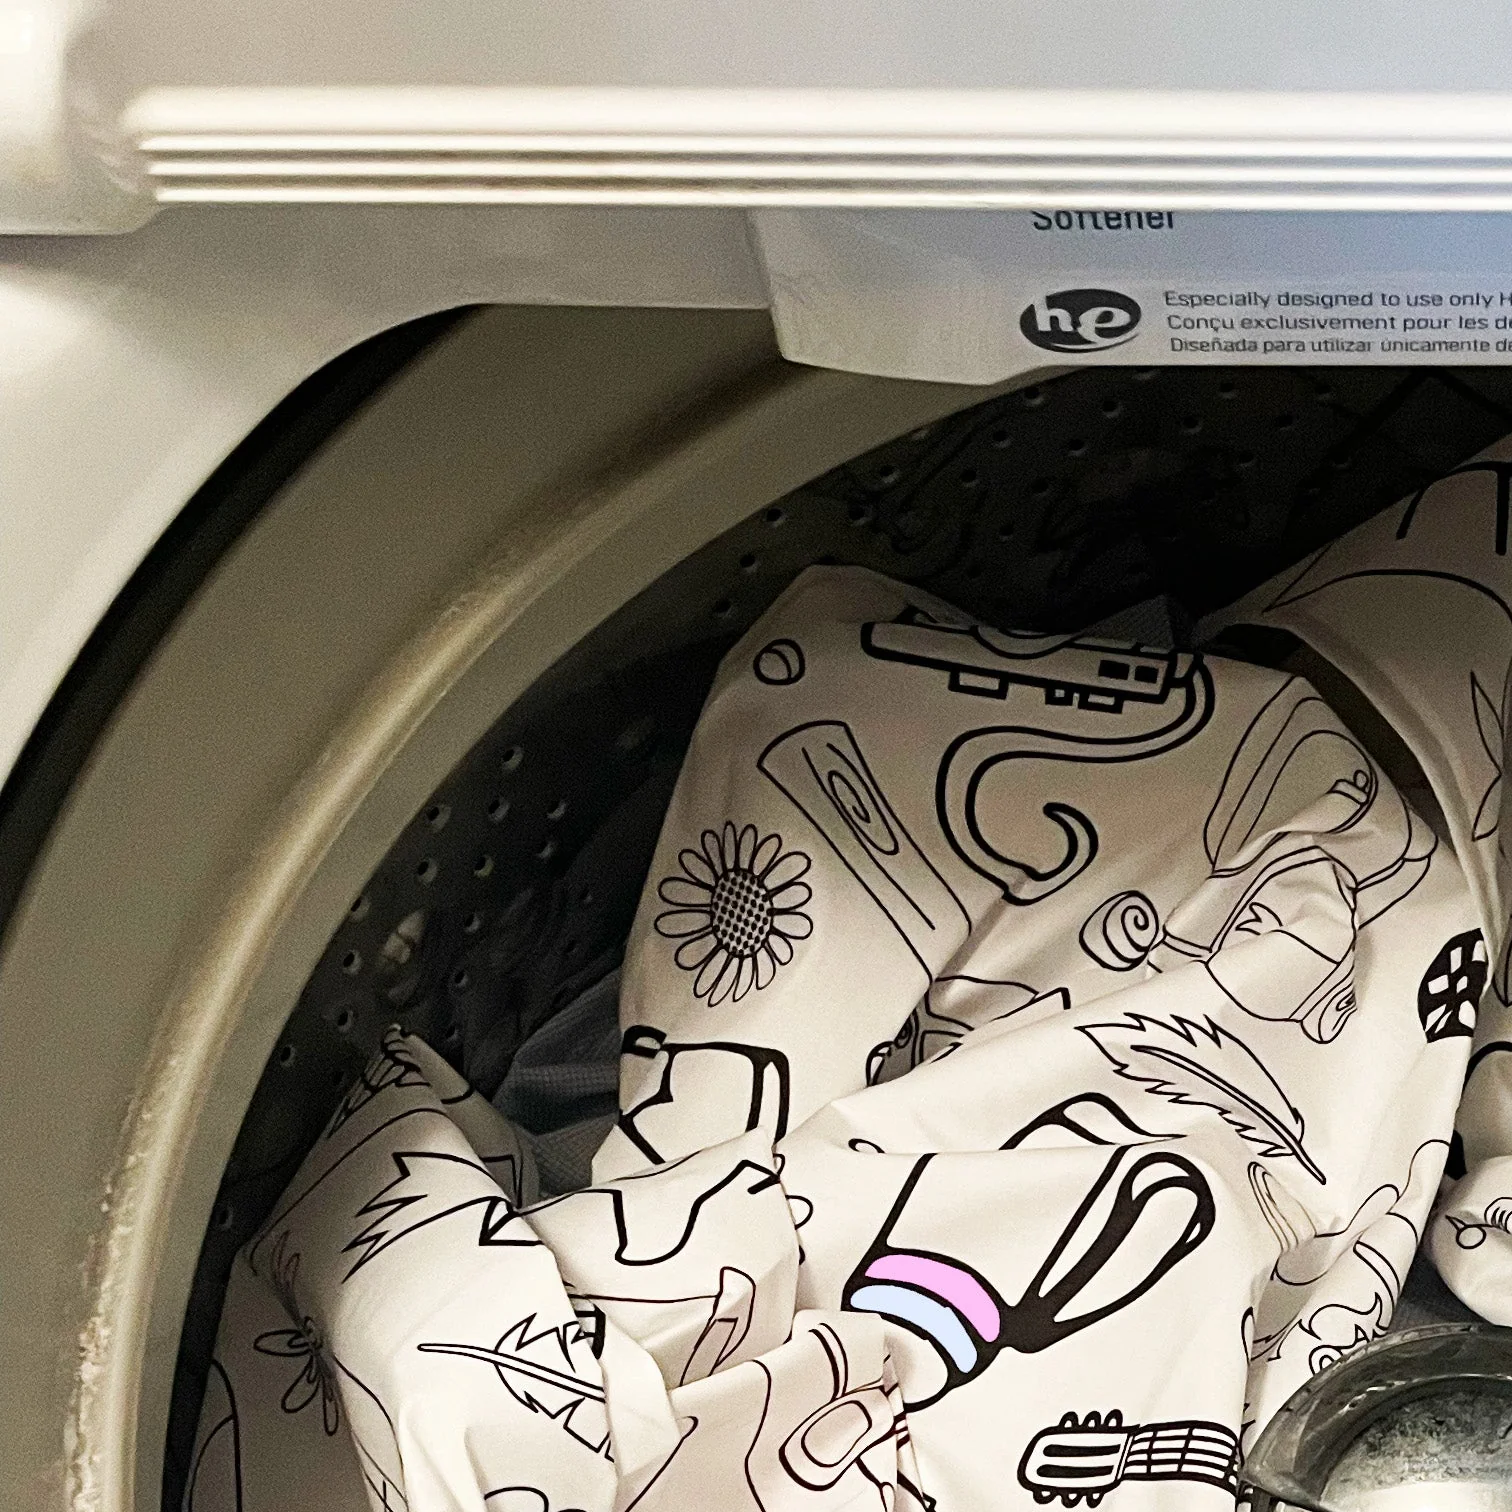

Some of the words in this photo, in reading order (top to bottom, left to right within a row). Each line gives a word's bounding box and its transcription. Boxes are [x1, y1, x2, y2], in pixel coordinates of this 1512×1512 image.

[1031, 210, 1174, 231] Softener
[1164, 290, 1270, 309] Especially
[1277, 292, 1373, 309] designed
[1380, 292, 1400, 307] to
[1406, 294, 1443, 307] use
[1449, 292, 1494, 309] only
[1166, 314, 1234, 332] Conçu
[1240, 315, 1398, 330] exclusivement
[1402, 317, 1451, 332] pour
[1458, 315, 1489, 330] les
[1170, 336, 1259, 352] Diseñada
[1263, 340, 1306, 354] para
[1311, 337, 1373, 352] utilizar
[1380, 338, 1490, 353] únicamente
